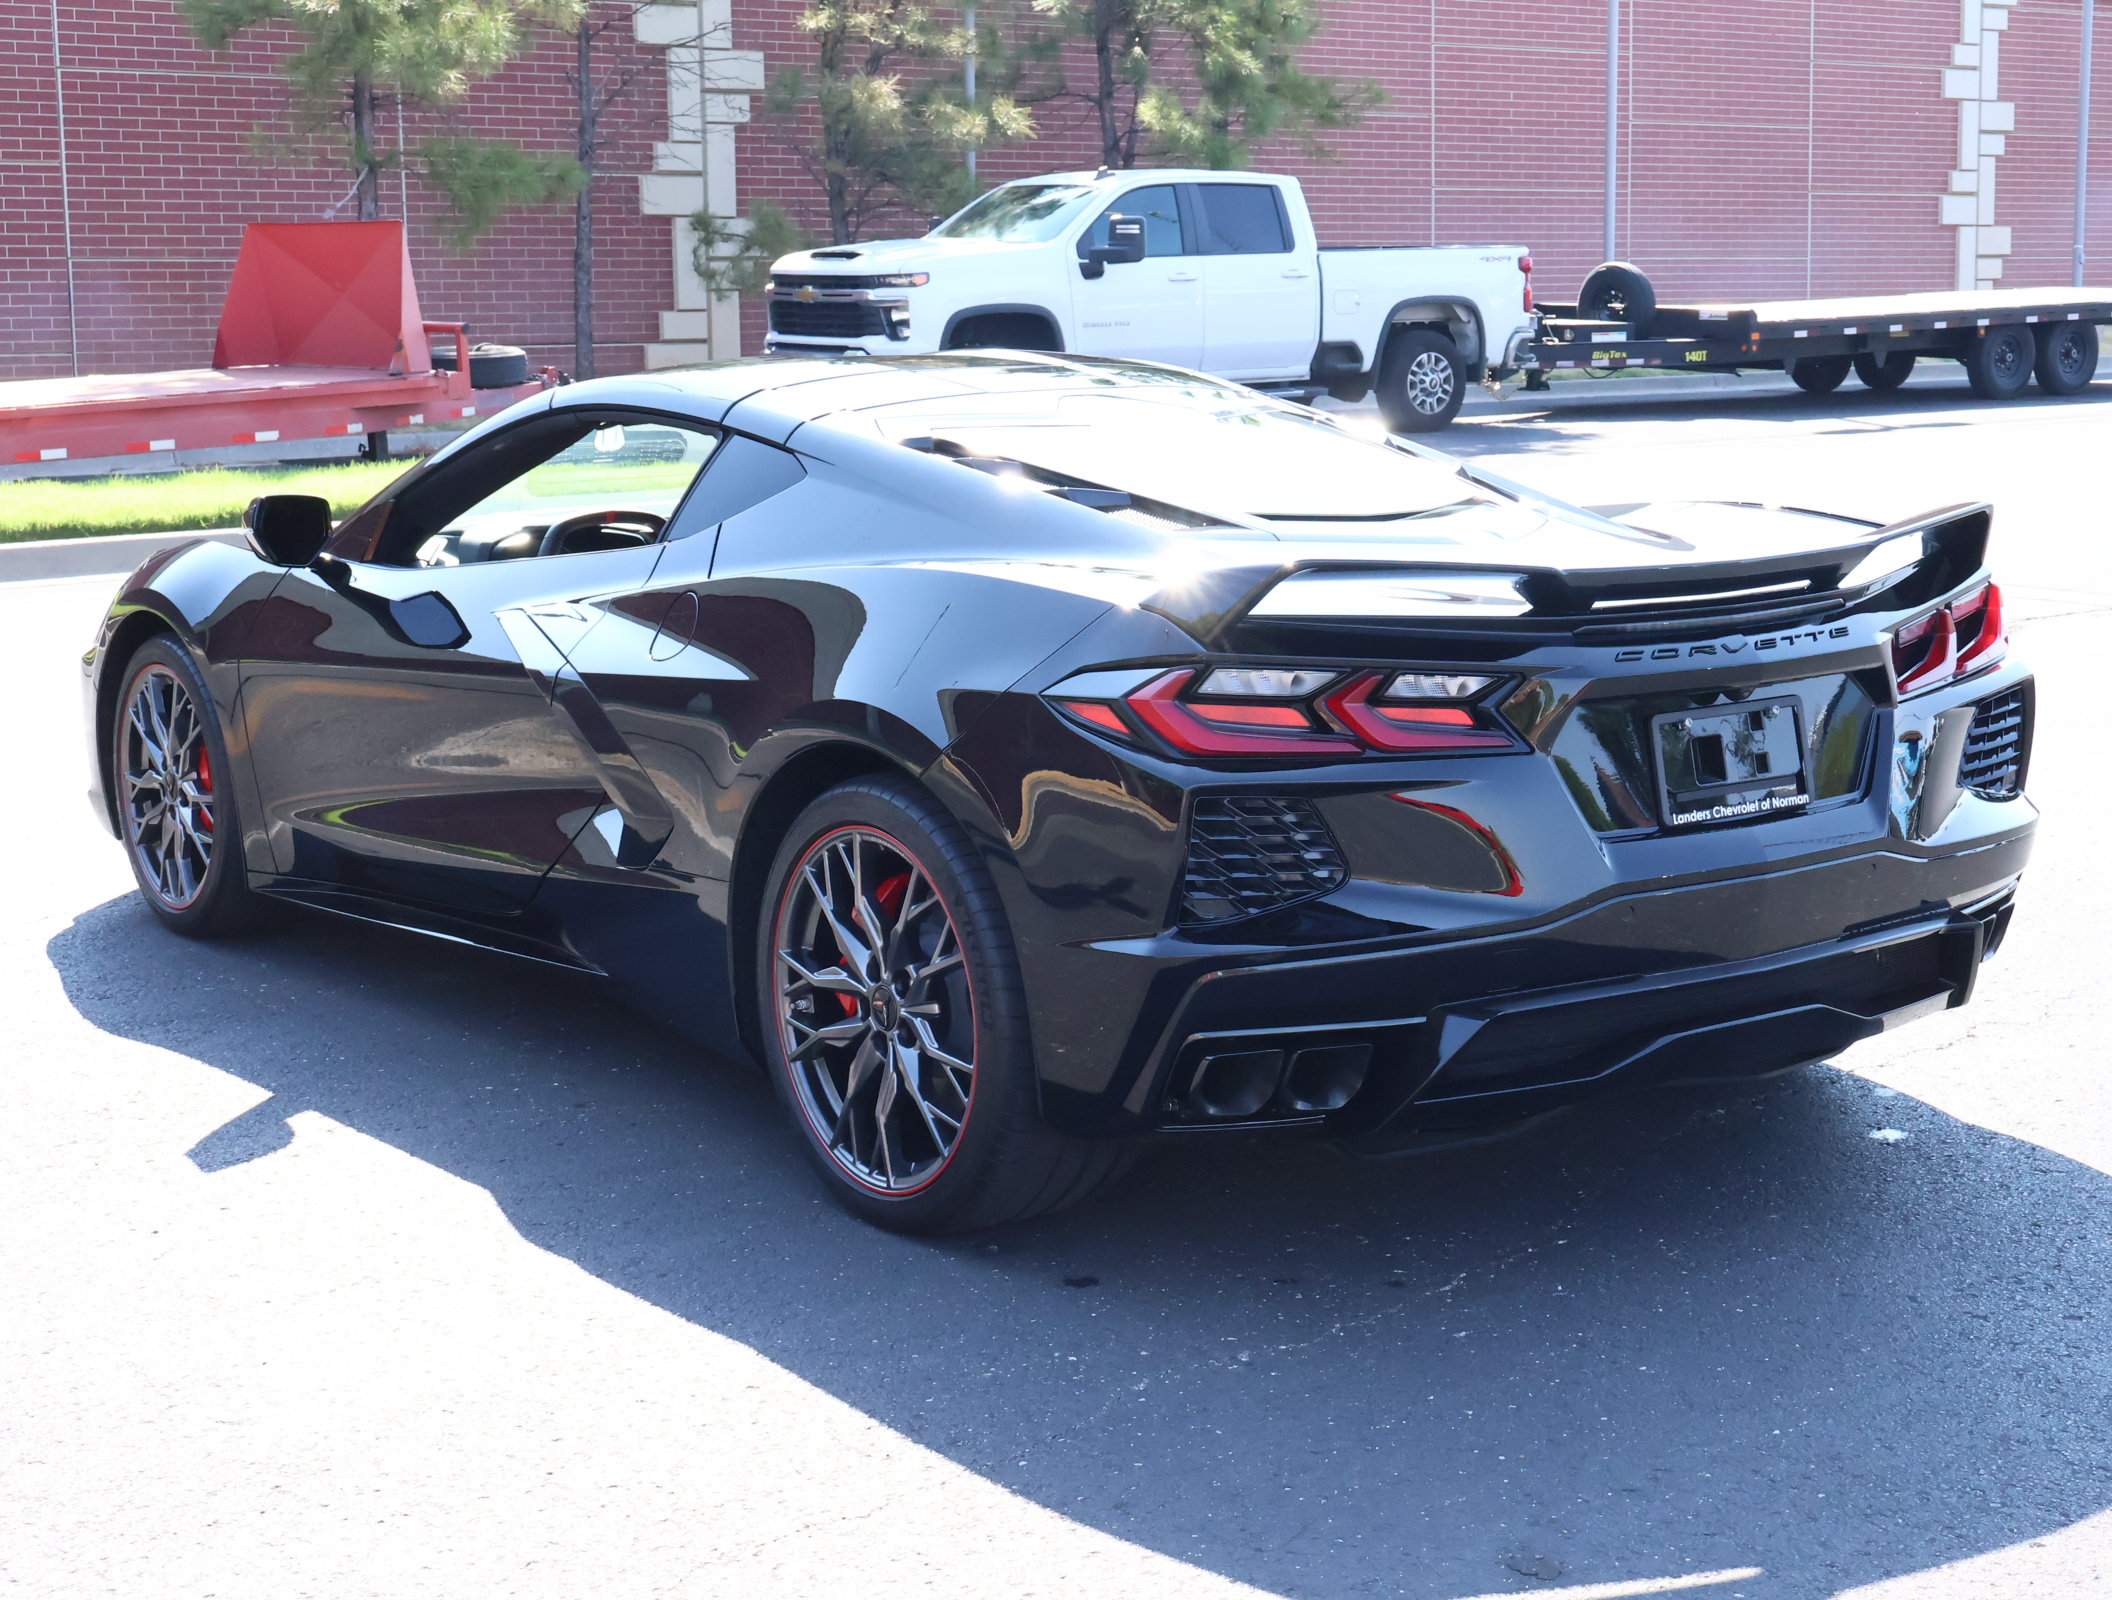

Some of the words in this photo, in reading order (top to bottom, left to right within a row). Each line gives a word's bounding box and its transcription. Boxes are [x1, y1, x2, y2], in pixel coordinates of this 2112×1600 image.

[1685, 350, 1707, 362] 140T
[1614, 626, 1850, 663] CORVETTE
[1673, 809, 1711, 825] Landers
[1712, 801, 1760, 818] Chevrolet
[1761, 798, 1771, 810] of
[1772, 794, 1810, 808] Norman
